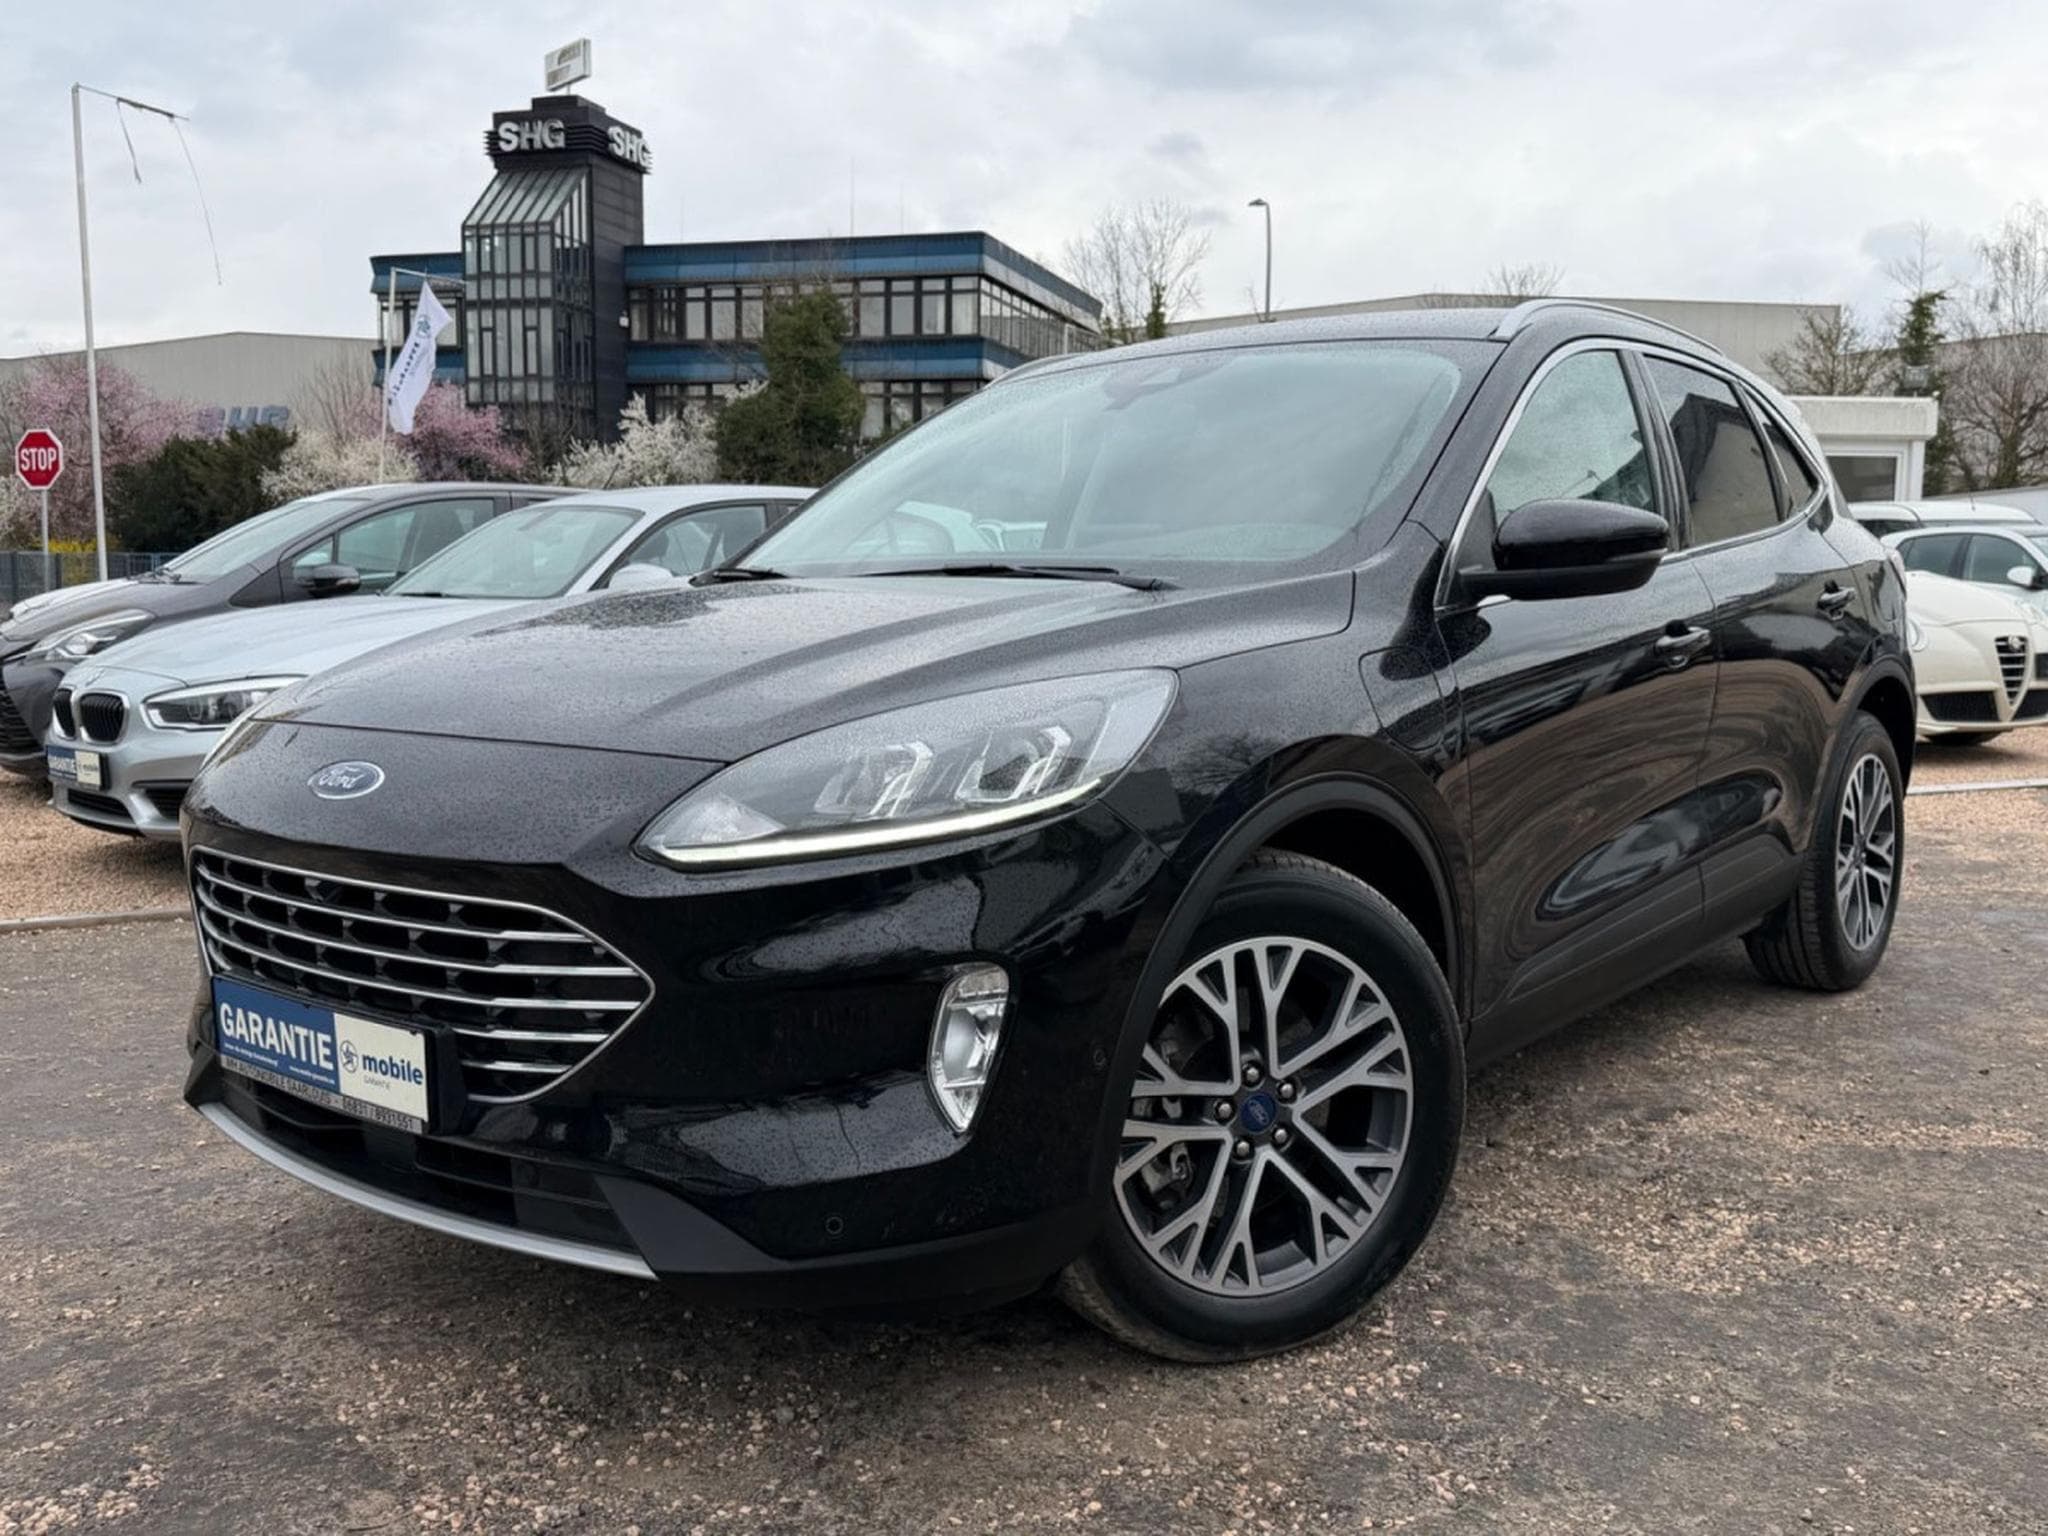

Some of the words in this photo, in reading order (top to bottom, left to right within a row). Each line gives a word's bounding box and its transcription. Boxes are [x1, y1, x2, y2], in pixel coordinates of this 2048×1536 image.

[499, 118, 565, 152] SHG
[608, 126, 652, 168] SHG
[20, 447, 57, 471] STOP
[318, 765, 365, 789] Ford
[220, 1002, 334, 1071] GARANTIE
[362, 1054, 424, 1086] mobile
